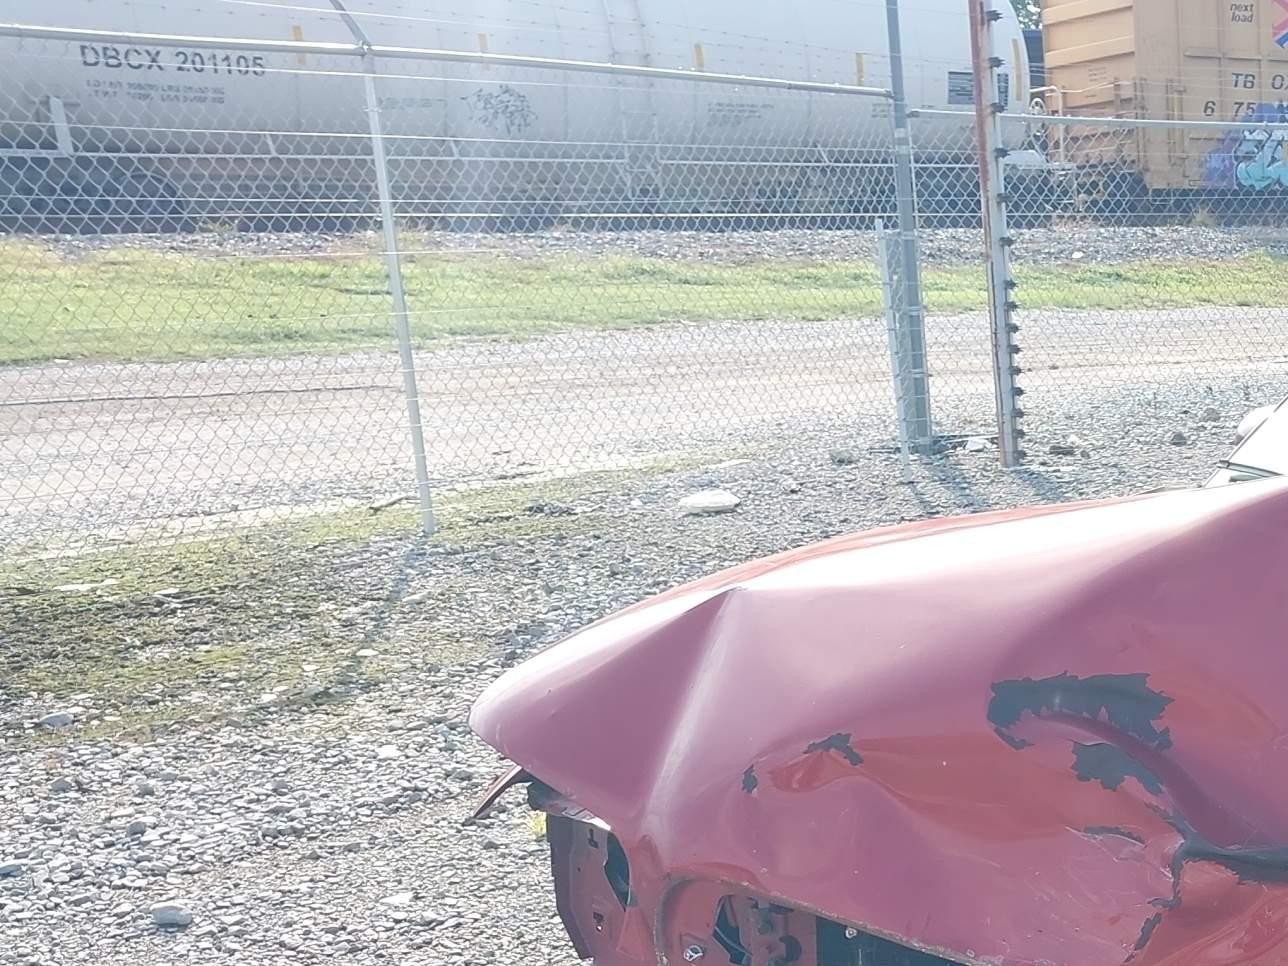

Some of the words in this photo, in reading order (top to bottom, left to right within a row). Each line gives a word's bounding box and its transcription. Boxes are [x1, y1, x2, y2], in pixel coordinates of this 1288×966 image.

[1230, 3, 1254, 12] next
[1231, 12, 1253, 23] load
[80, 44, 164, 71] DBCX
[175, 51, 265, 77] 201105
